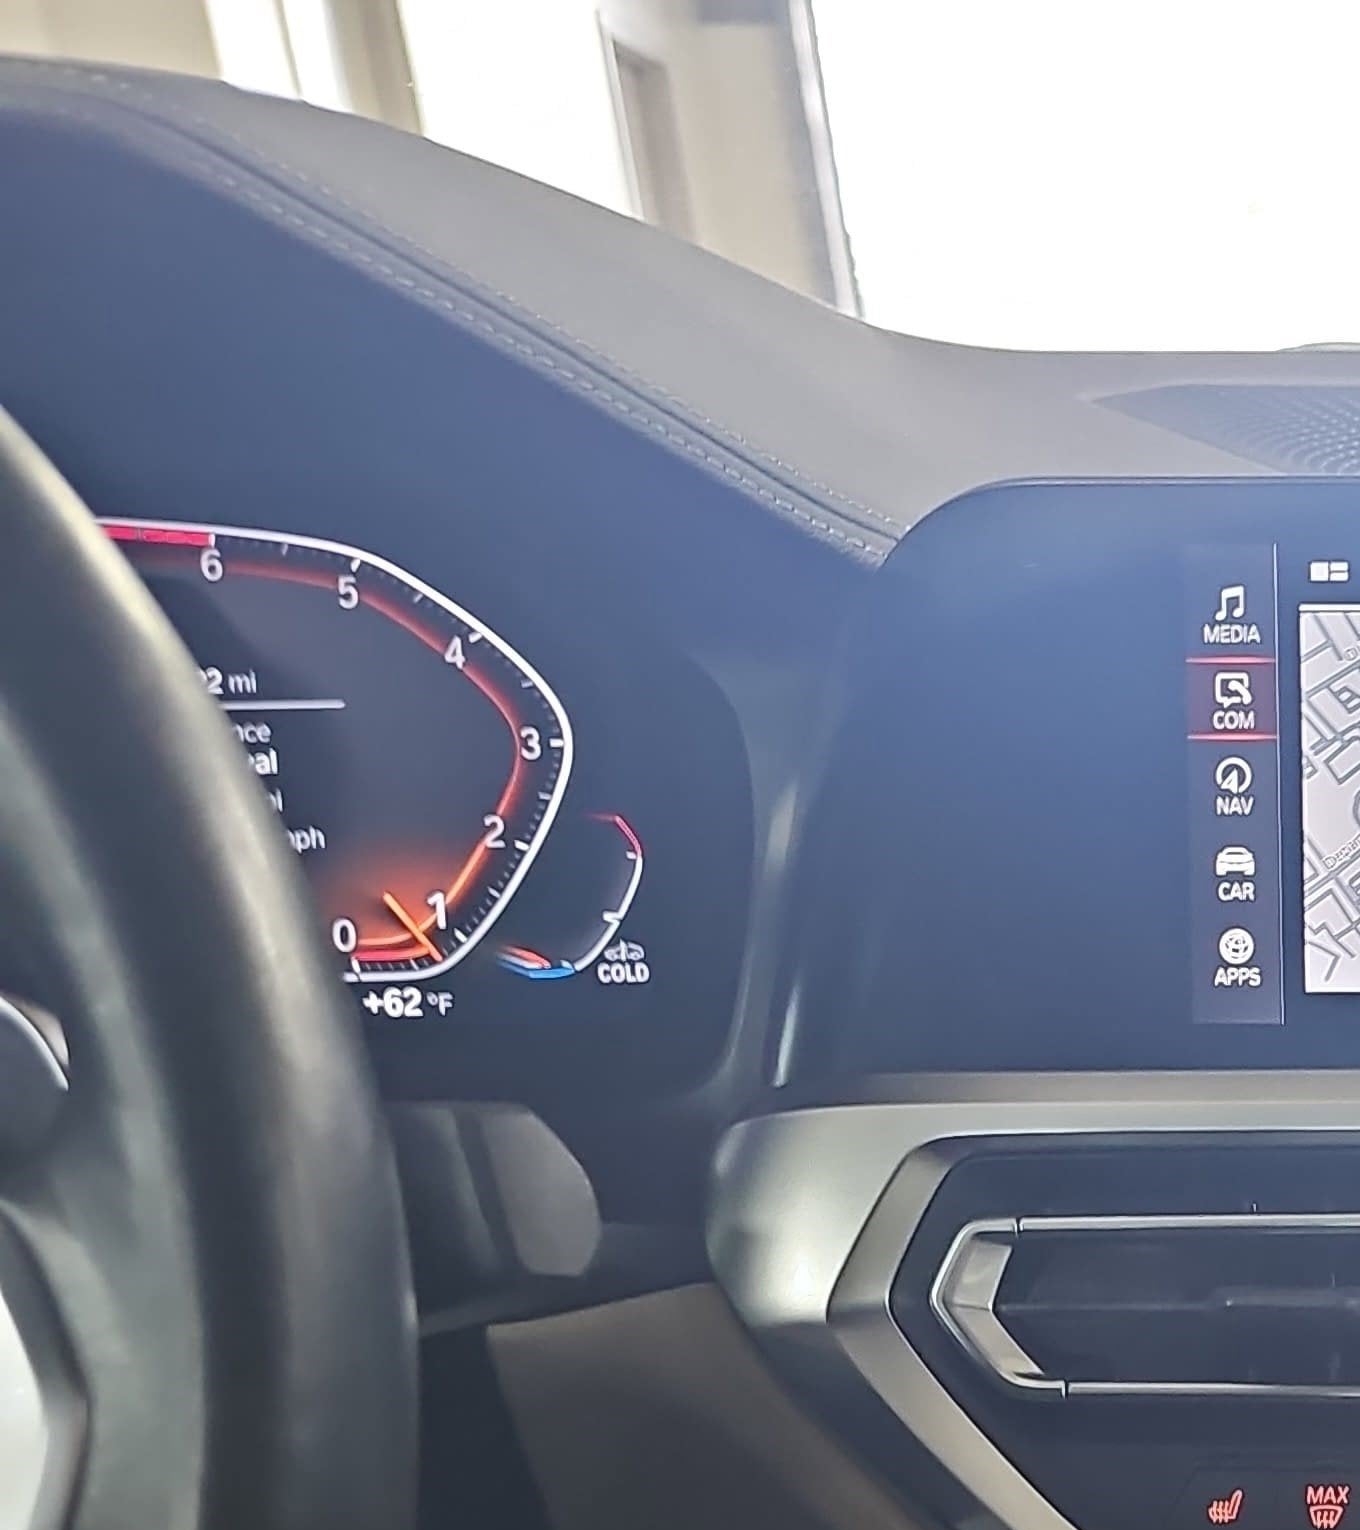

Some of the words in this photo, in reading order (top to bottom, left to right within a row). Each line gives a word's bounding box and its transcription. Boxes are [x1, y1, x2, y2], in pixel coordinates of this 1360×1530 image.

[200, 552, 223, 582] 6
[337, 579, 359, 608] 5
[1203, 624, 1260, 645] MEDIA
[444, 637, 467, 668] 4
[228, 668, 257, 694] mi
[1213, 711, 1256, 730] COM
[521, 729, 542, 759] 3
[1216, 795, 1254, 816] NAV
[484, 817, 505, 848] 2
[1218, 882, 1255, 902] CAR
[428, 892, 448, 930] 1
[332, 919, 357, 952] 0
[598, 963, 650, 984] COLD
[1214, 966, 1261, 987] APPS
[363, 990, 423, 1018] +62
[1306, 1486, 1349, 1505] MAX
